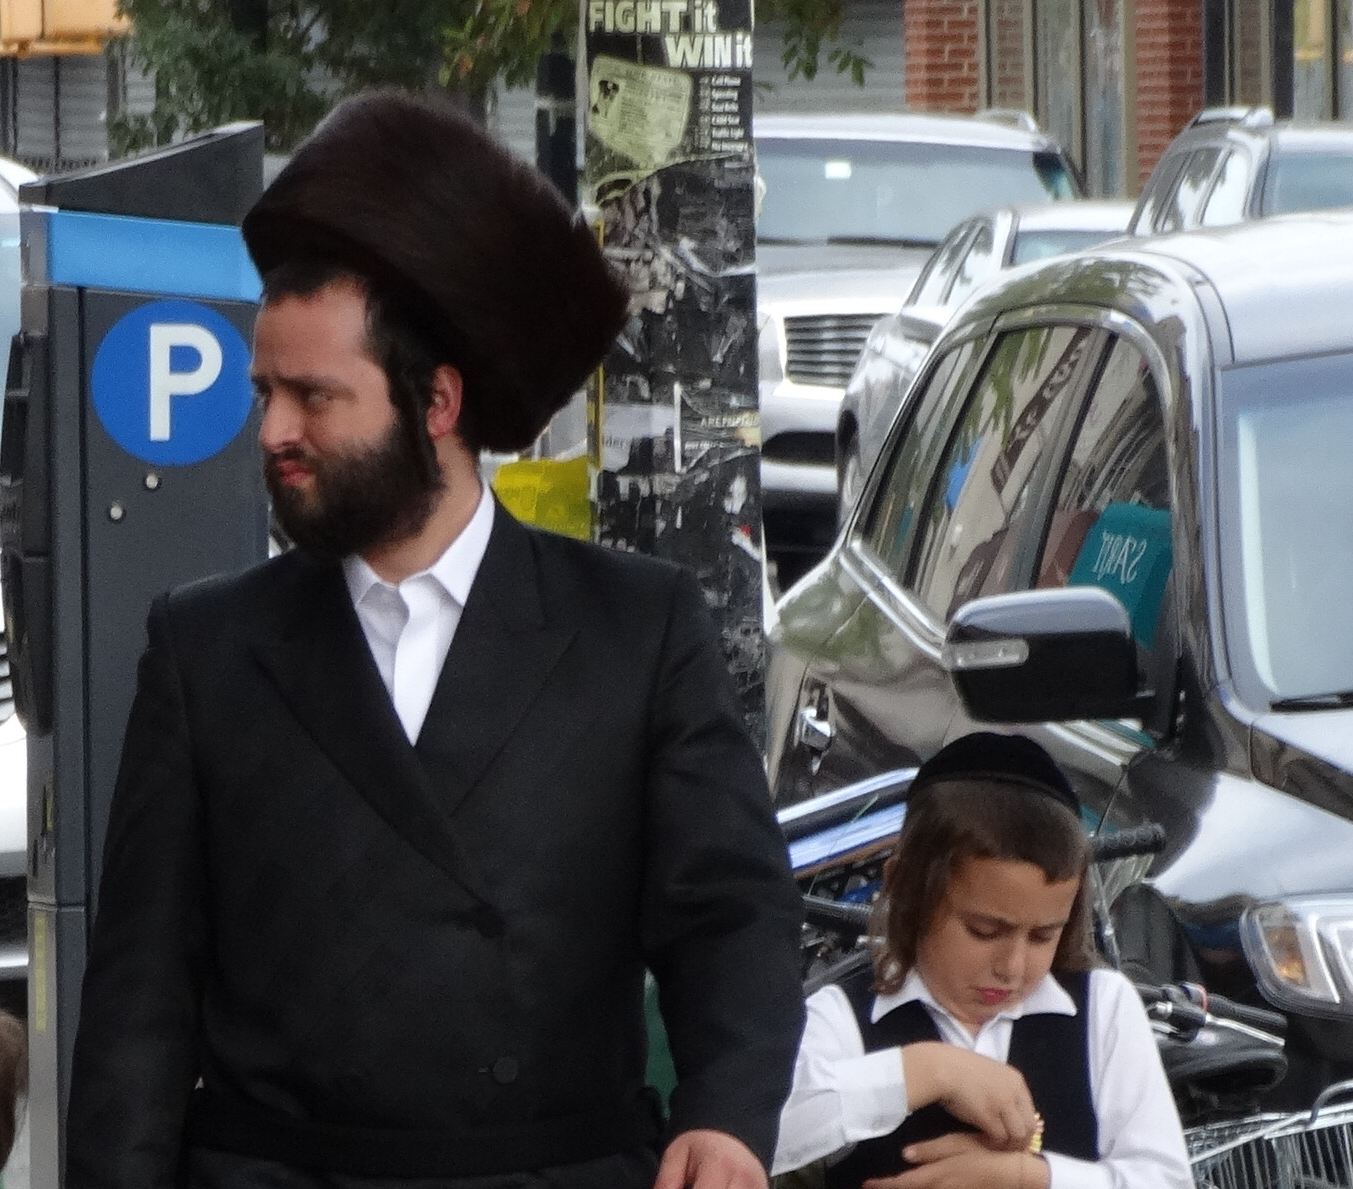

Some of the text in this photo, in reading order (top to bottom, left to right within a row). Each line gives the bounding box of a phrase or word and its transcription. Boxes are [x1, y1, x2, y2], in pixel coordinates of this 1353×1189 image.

[588, 0, 717, 33] FIGHT it
[665, 32, 753, 68] WIN it
[149, 322, 223, 441] P
